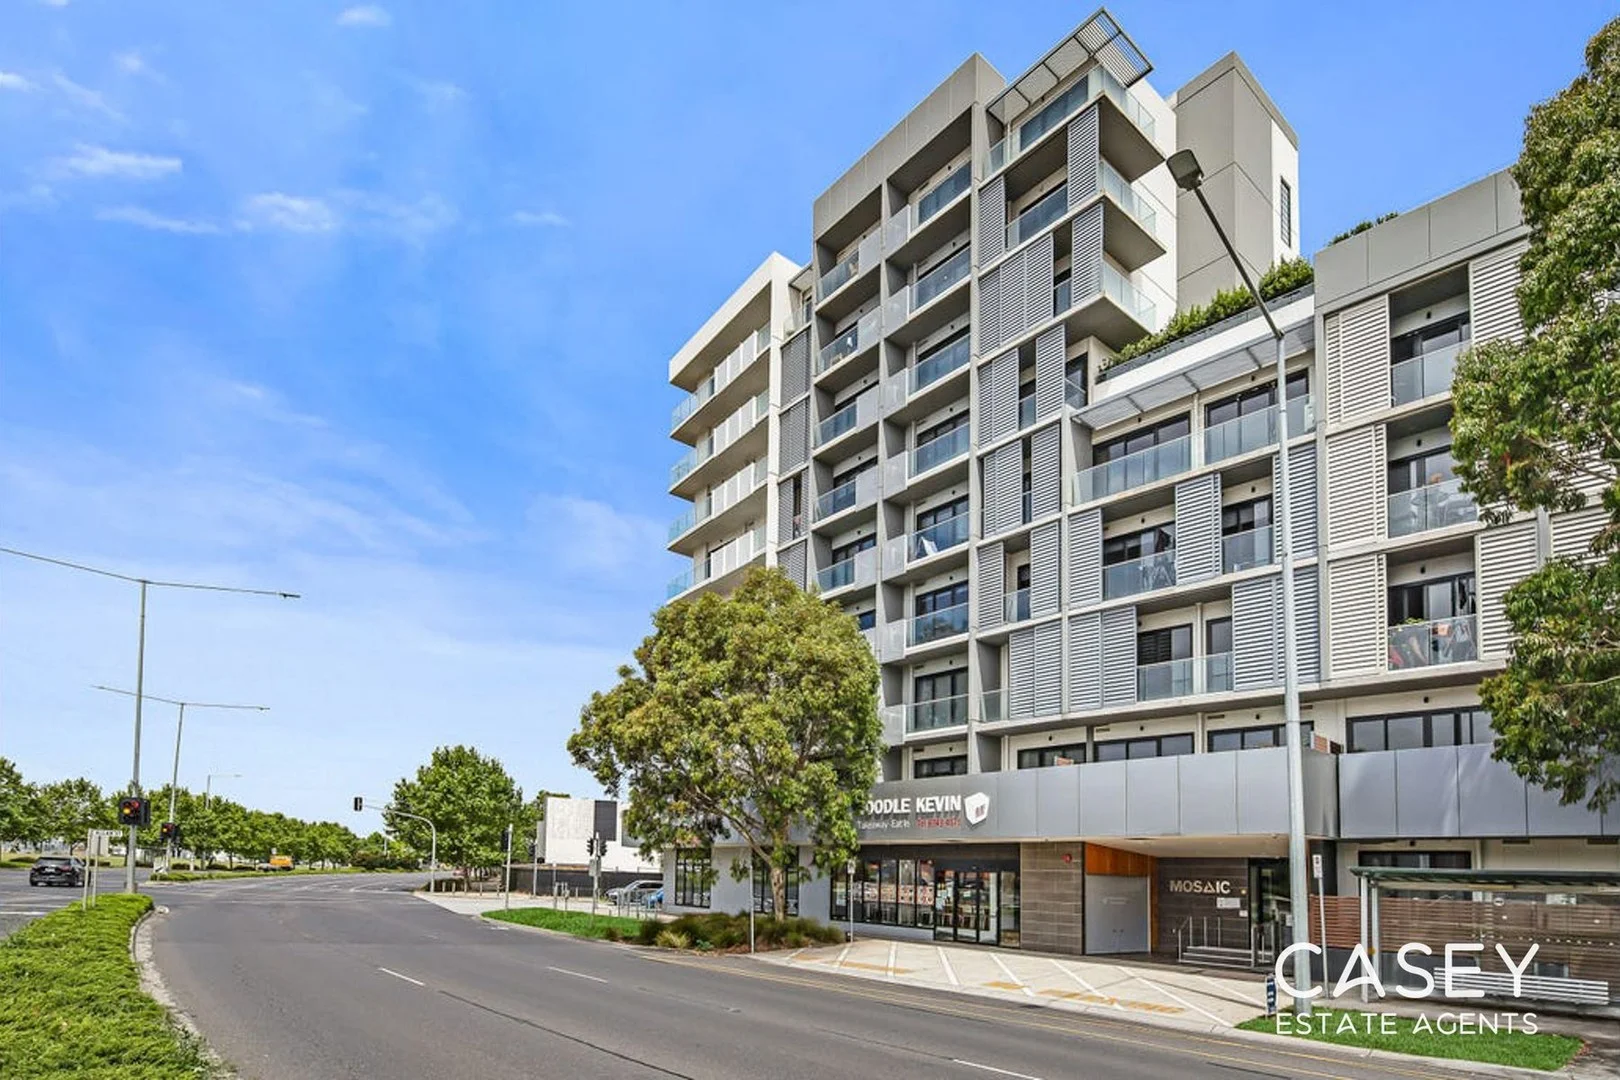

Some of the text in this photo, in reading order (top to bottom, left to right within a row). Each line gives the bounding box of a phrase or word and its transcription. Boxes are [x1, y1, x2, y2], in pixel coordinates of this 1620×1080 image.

[862, 798, 911, 814] OODLE
[916, 795, 961, 813] KEVIN
[1169, 880, 1231, 894] MOSAIC
